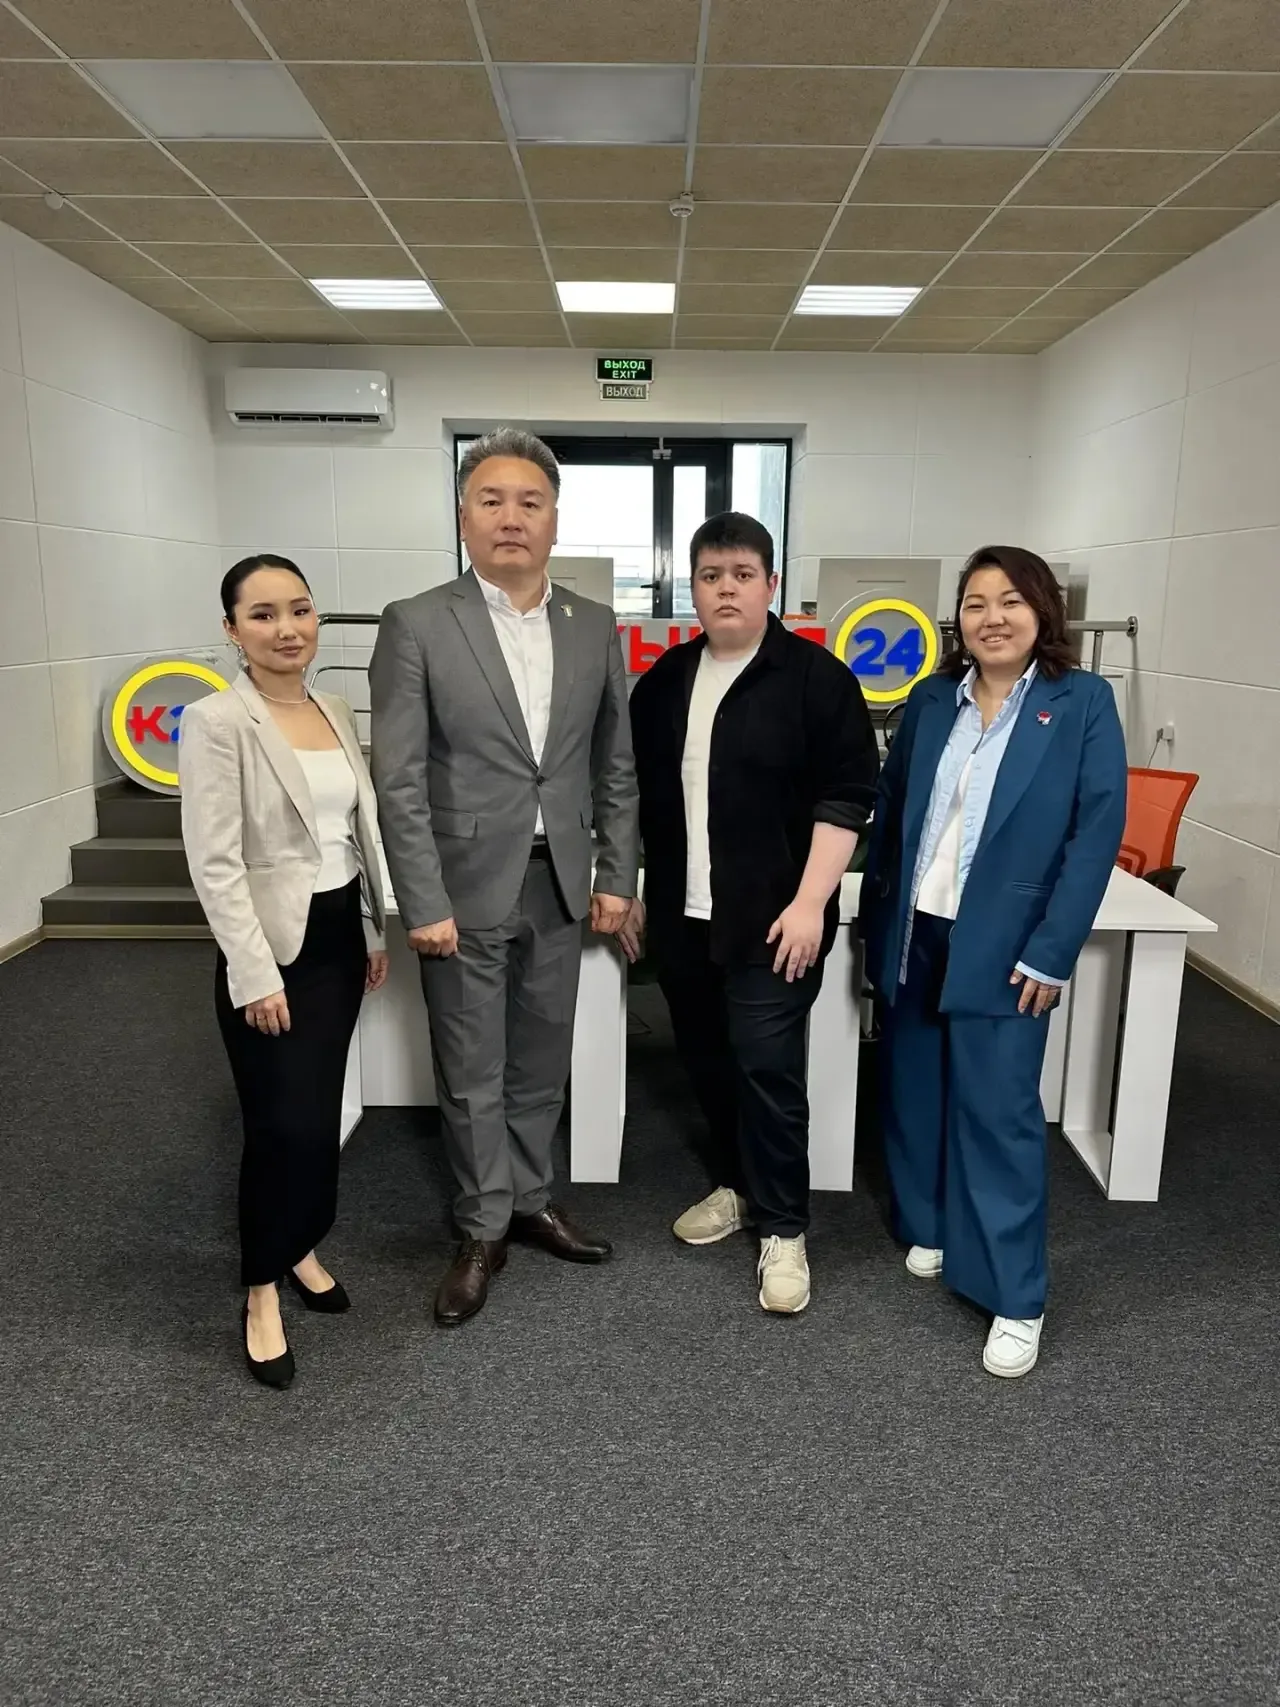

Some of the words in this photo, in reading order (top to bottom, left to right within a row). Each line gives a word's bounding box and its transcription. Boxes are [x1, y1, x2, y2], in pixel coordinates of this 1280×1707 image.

[604, 360, 646, 370] ВЫХОД
[612, 370, 637, 379] EXIT
[606, 386, 644, 397] ВЫХОД
[852, 627, 925, 676] 24
